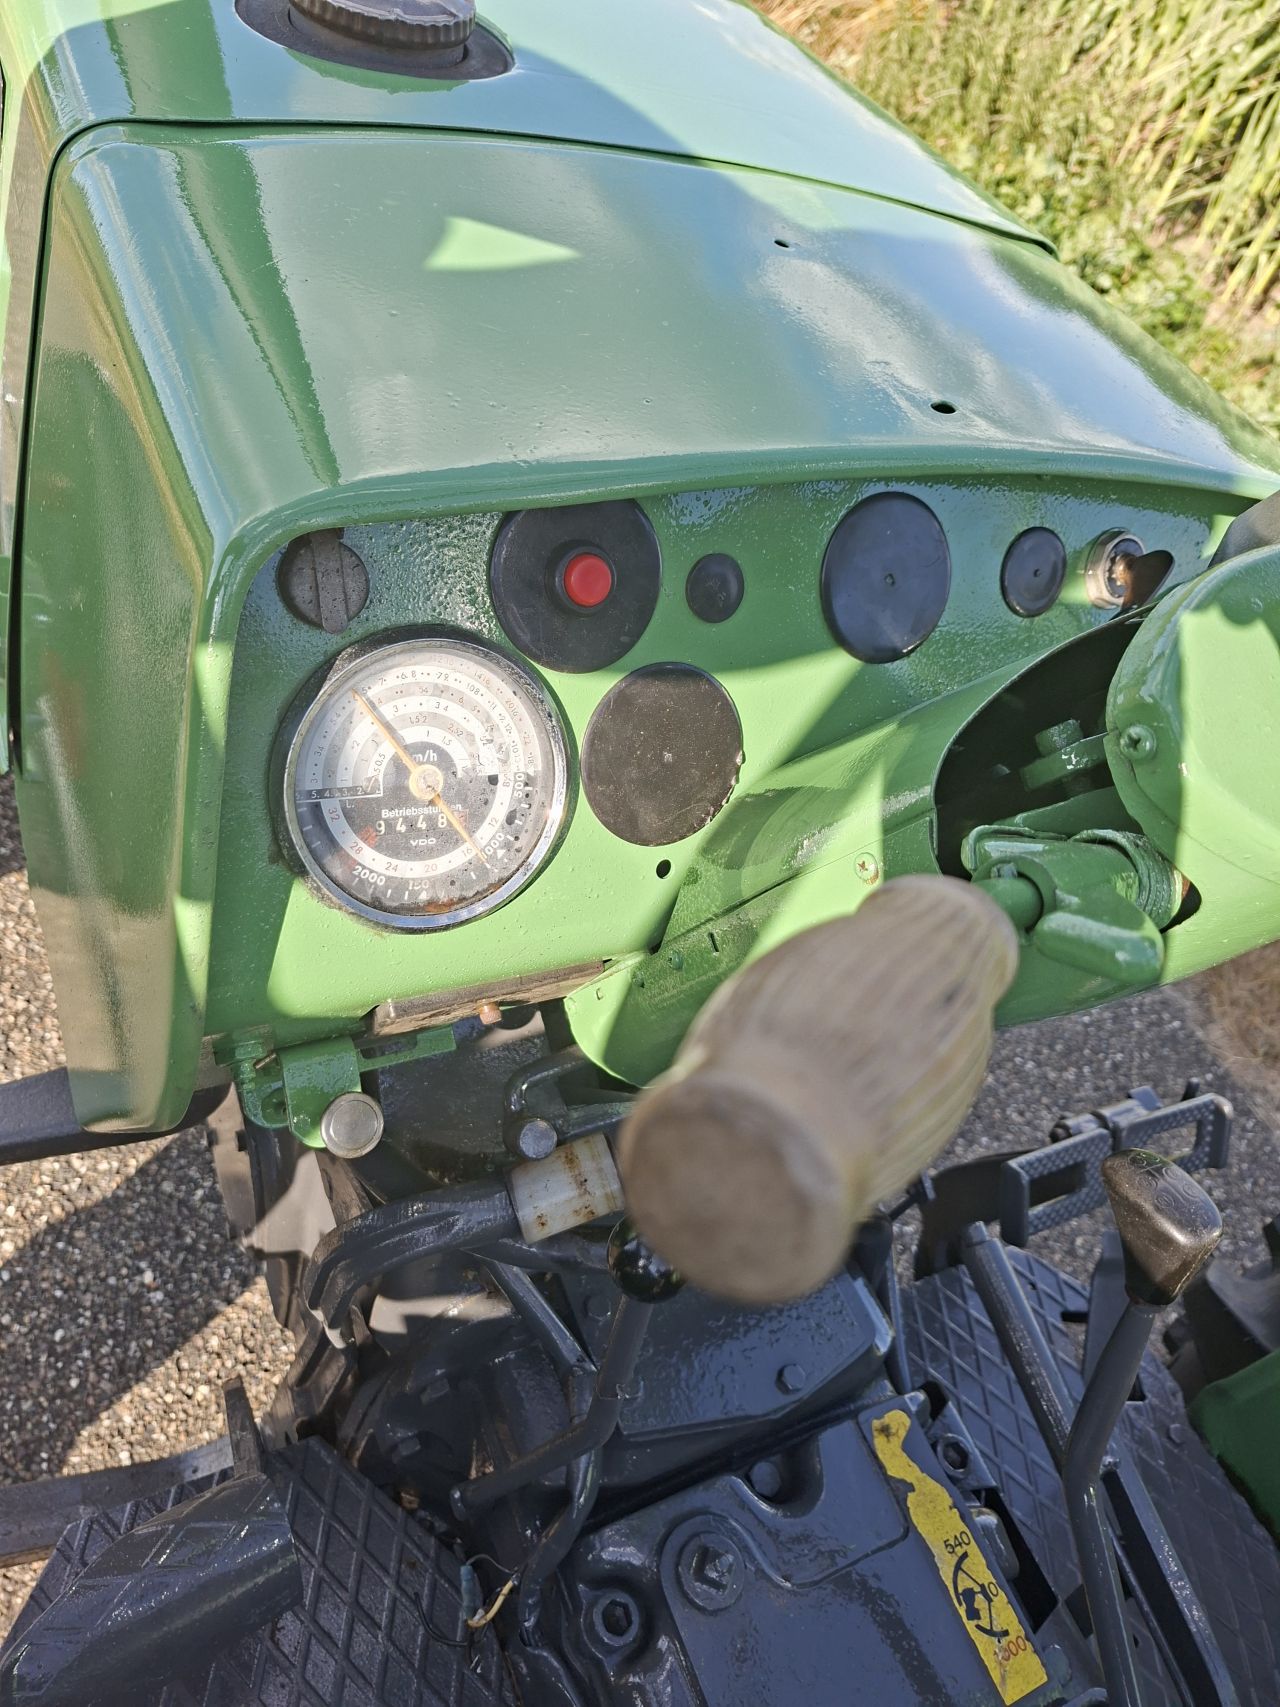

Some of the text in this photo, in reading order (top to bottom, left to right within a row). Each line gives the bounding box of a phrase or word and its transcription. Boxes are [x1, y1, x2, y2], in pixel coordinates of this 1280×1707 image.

[381, 803, 462, 819] Betriebsstuen
[410, 838, 437, 847] VDO
[384, 861, 399, 872] 24
[352, 865, 386, 886] 2000
[943, 1530, 971, 1554] 540
